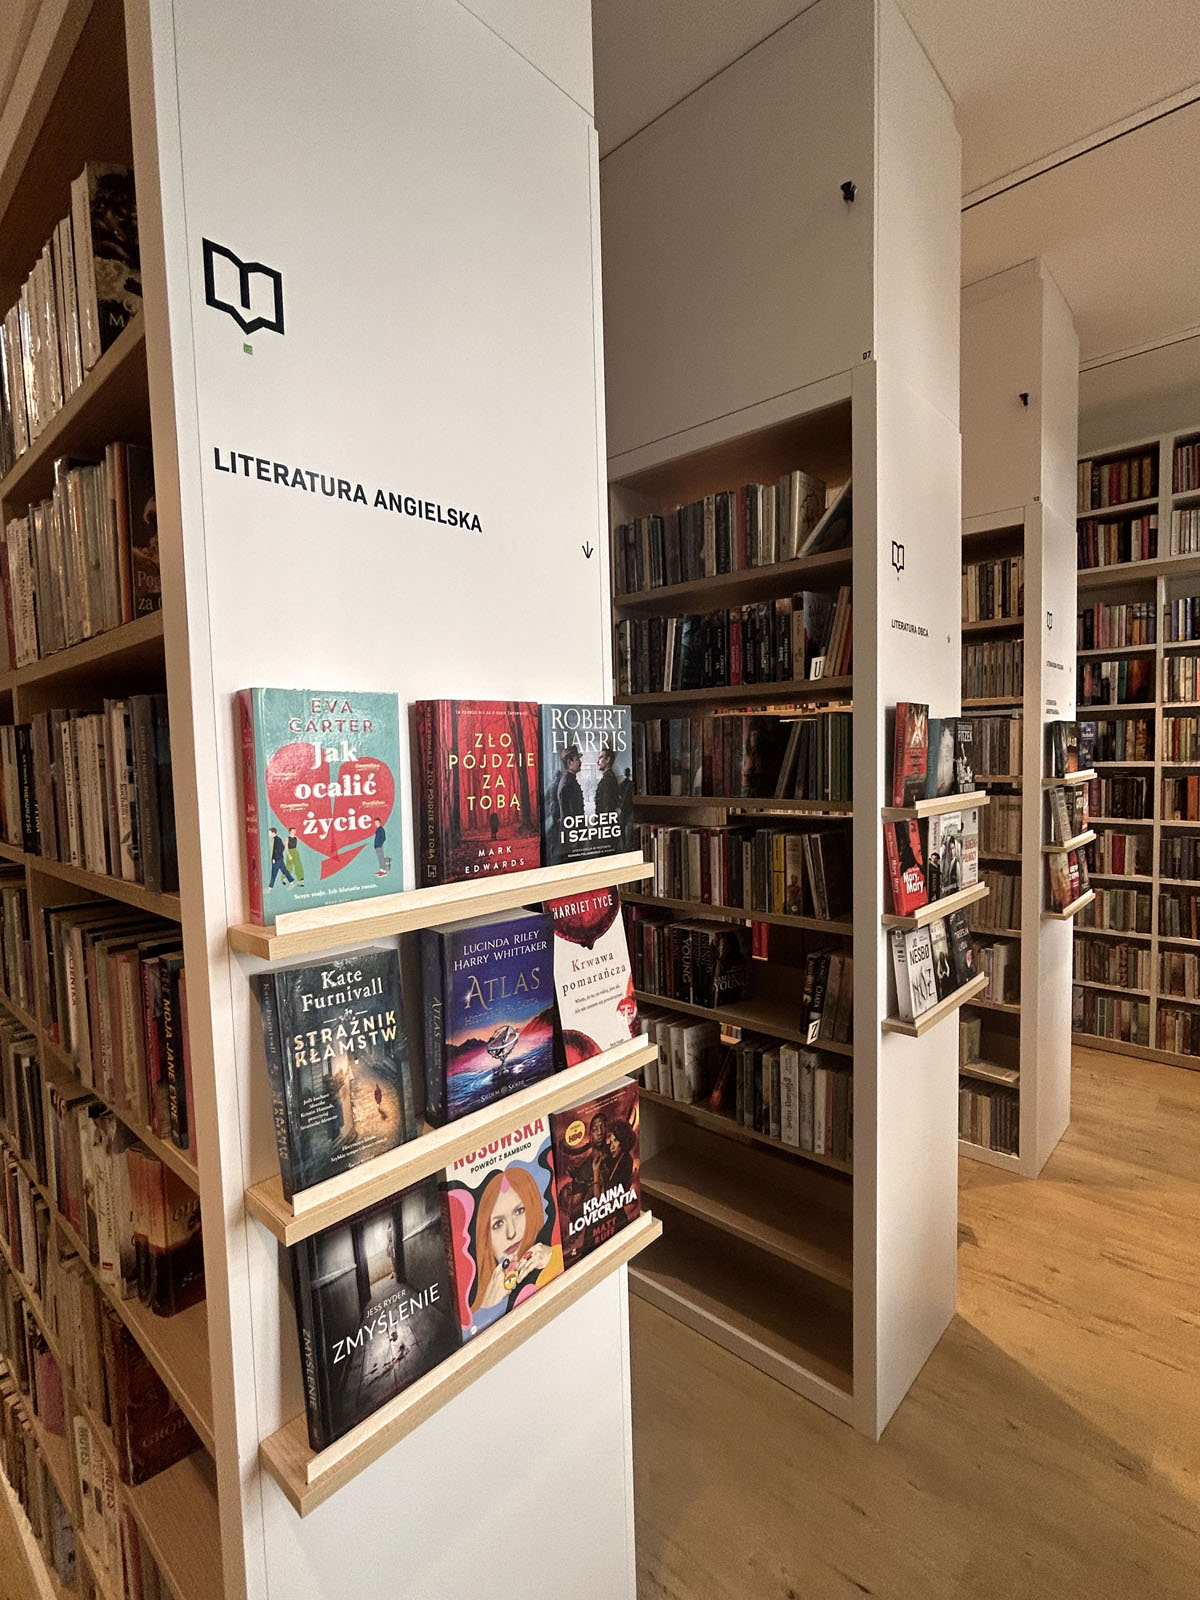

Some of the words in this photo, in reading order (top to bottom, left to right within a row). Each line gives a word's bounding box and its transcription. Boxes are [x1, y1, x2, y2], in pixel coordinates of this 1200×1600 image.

[213, 447, 368, 505] LITERATURA
[373, 489, 483, 533] ANGIELSKA
[814, 660, 823, 678] U
[311, 698, 353, 714] EVA
[551, 708, 627, 730] ROBERT
[289, 718, 374, 733] CARTER
[474, 732, 512, 748] ZŁO
[551, 730, 628, 754] HARRIS
[311, 740, 359, 769] Jak
[448, 750, 536, 770] PÓJDZIE
[294, 772, 377, 799] ocalić
[482, 775, 506, 789] ZA
[467, 793, 521, 811] TOBĄ
[303, 808, 373, 840] życie
[563, 812, 619, 830] OFICER
[560, 830, 565, 844] I
[568, 825, 622, 843] SZPIEG
[478, 845, 513, 857] MARK
[465, 858, 525, 874] EDWARDS
[903, 872, 920, 884] Mary,
[906, 881, 924, 895] Mary
[552, 901, 591, 920] HARRIET
[592, 894, 614, 911] TYCE
[454, 954, 489, 971] HARRY
[493, 940, 548, 961] WHITTAKER
[463, 936, 510, 956] LUCINDA
[513, 930, 540, 946] RILEY
[909, 944, 930, 966] NESBØ
[571, 951, 614, 973] Krwawa
[681, 938, 691, 983] YOUNG
[321, 966, 363, 990] Kate
[464, 966, 541, 1011] ATLAS
[562, 964, 627, 996] pomarańcza
[301, 977, 384, 1012] Furnivall
[162, 999, 173, 1039] MOJA
[293, 1010, 397, 1050] STRAŻNIK
[432, 997, 443, 1037] ATLAS
[811, 1021, 818, 1040] Z
[295, 1025, 398, 1068] KŁAMSTW
[165, 1041, 178, 1080] JANE
[169, 1084, 179, 1123] EYRE
[470, 1156, 497, 1174] POWRÓT
[503, 1142, 532, 1159] BAMBUKO
[568, 1188, 638, 1236] LOVECRAFTA
[583, 1183, 625, 1215] KRAINA
[592, 1216, 617, 1237] MATT
[594, 1226, 615, 1245] RUFF
[365, 1302, 383, 1318] JESS
[383, 1289, 407, 1309] RYDER
[332, 1282, 441, 1366] ZMYŚLENIE
